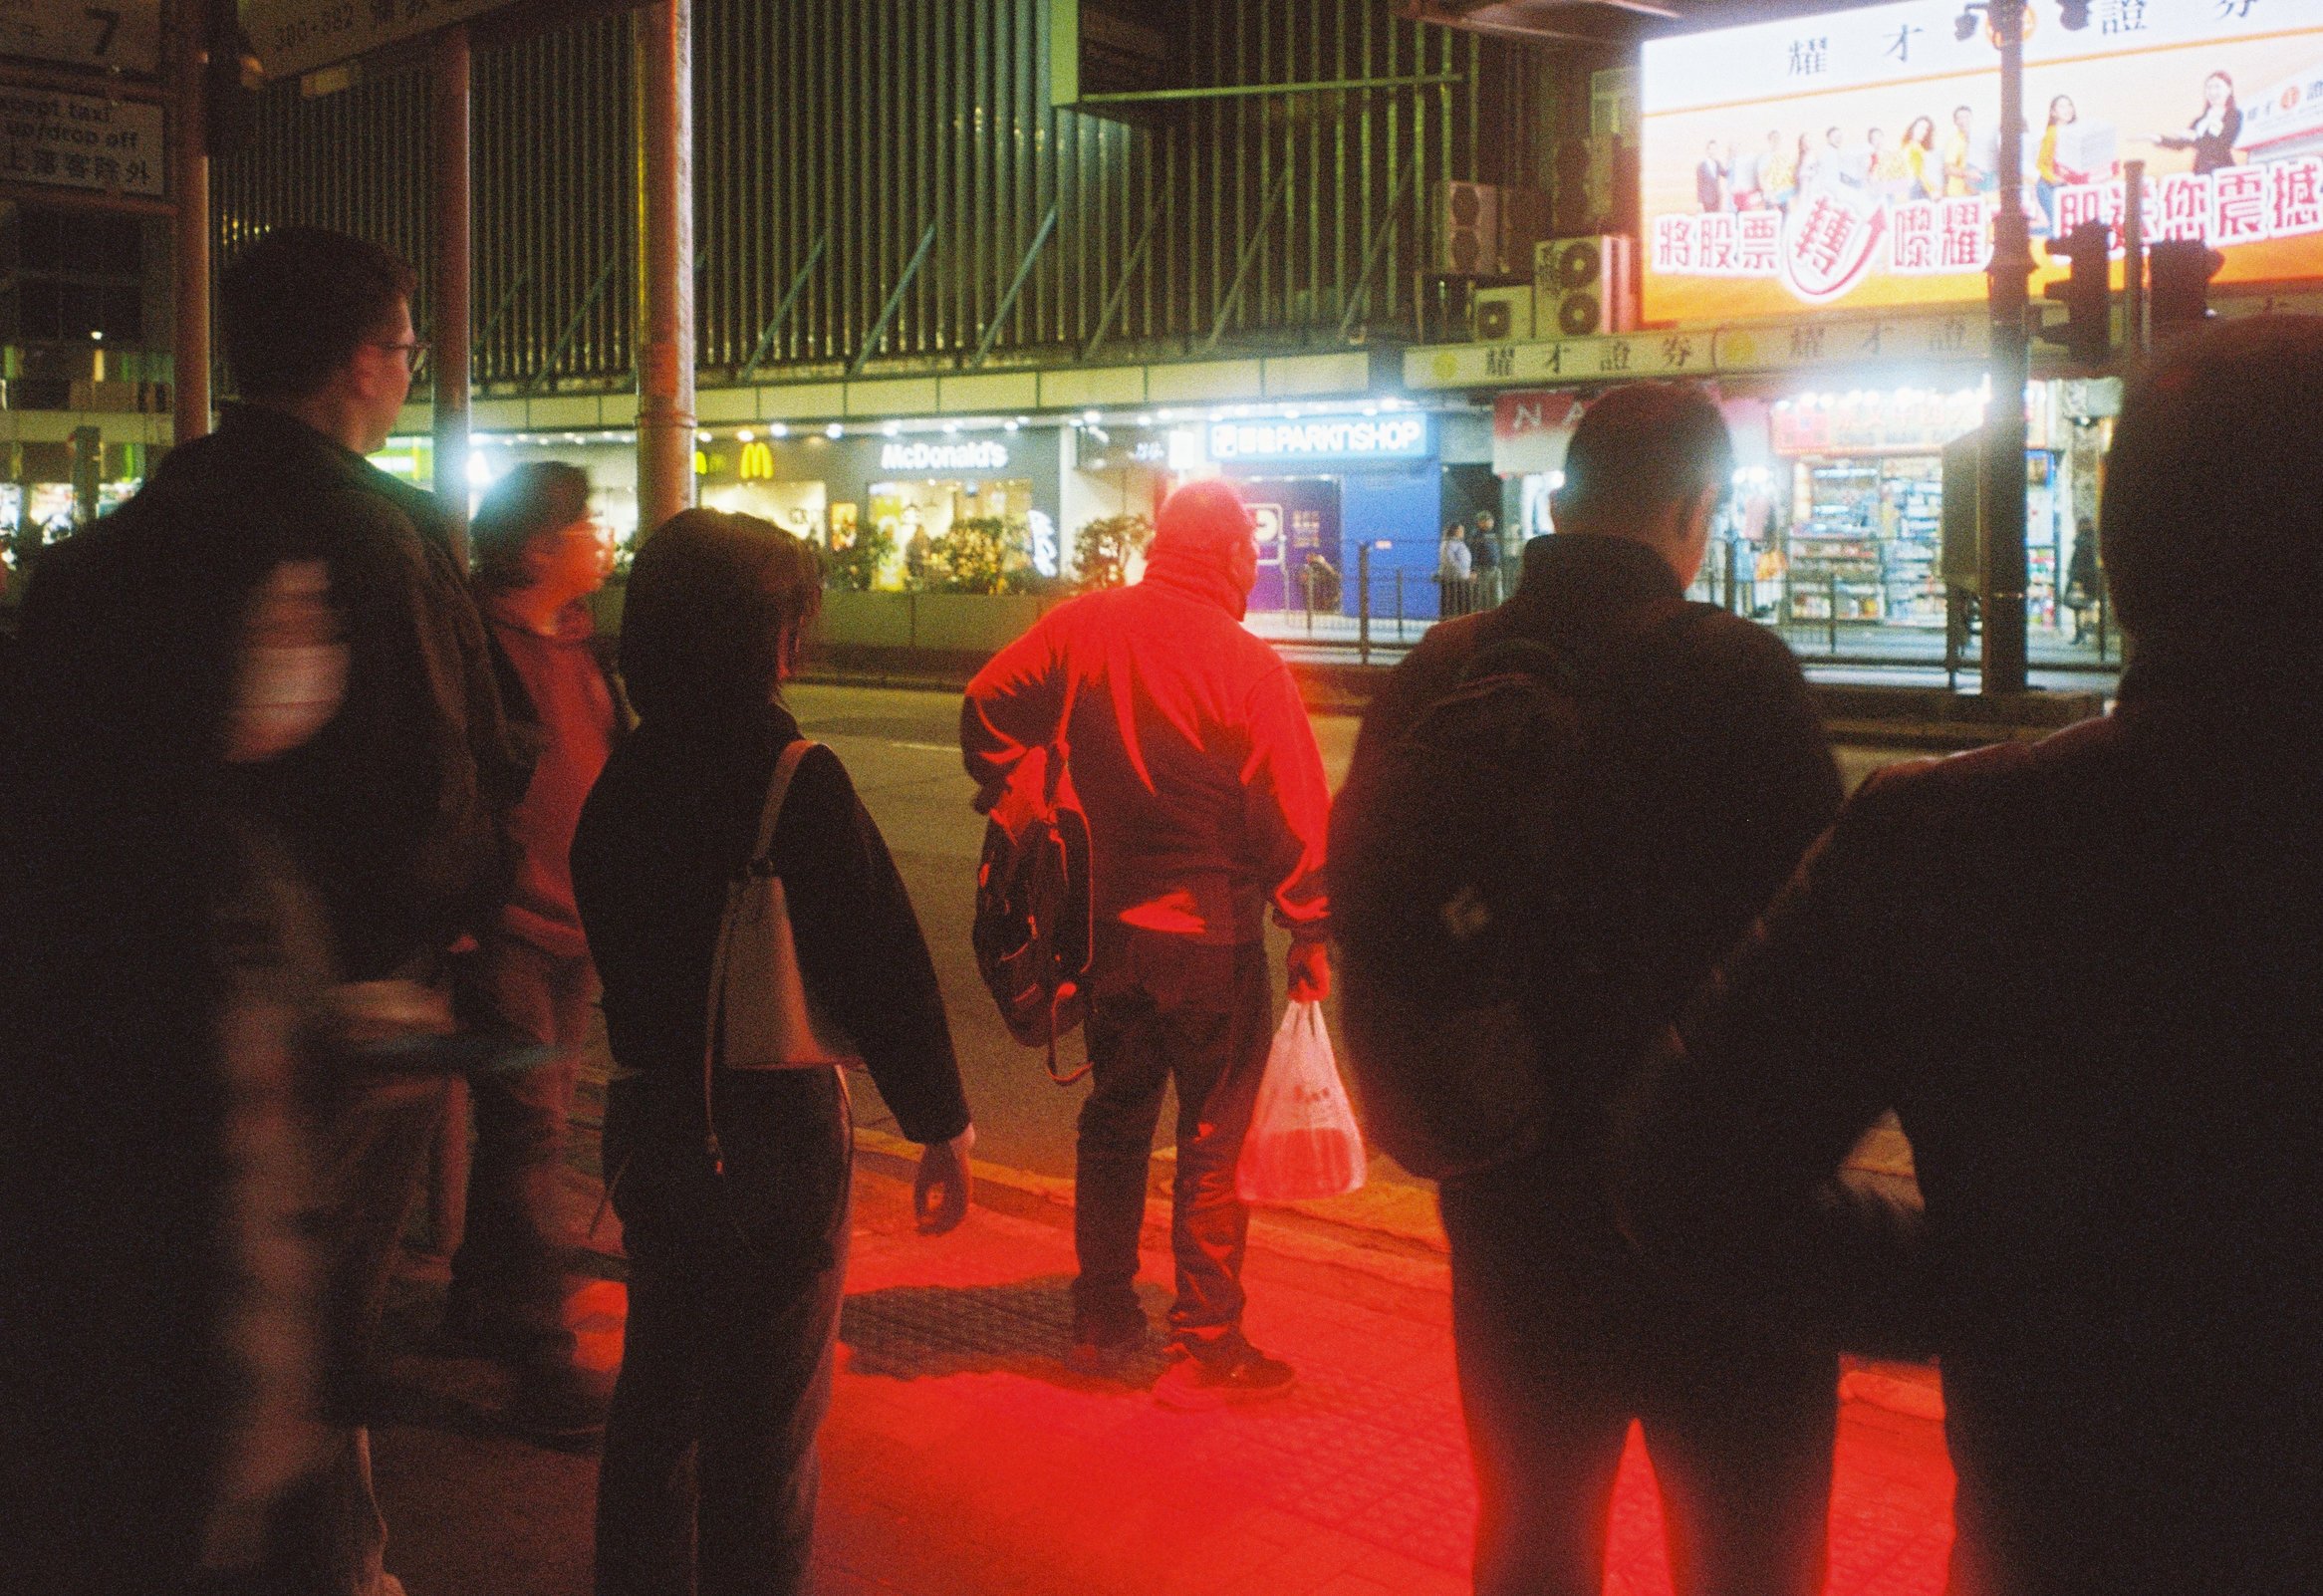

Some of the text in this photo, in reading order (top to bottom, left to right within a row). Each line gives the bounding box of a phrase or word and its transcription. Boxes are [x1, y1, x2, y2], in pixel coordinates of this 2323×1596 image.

[84, 7, 121, 57] 7
[69, 101, 111, 123] taxi
[105, 130, 139, 149] off
[1485, 336, 1691, 377] 耀才證券
[881, 440, 1008, 469] McDonald's
